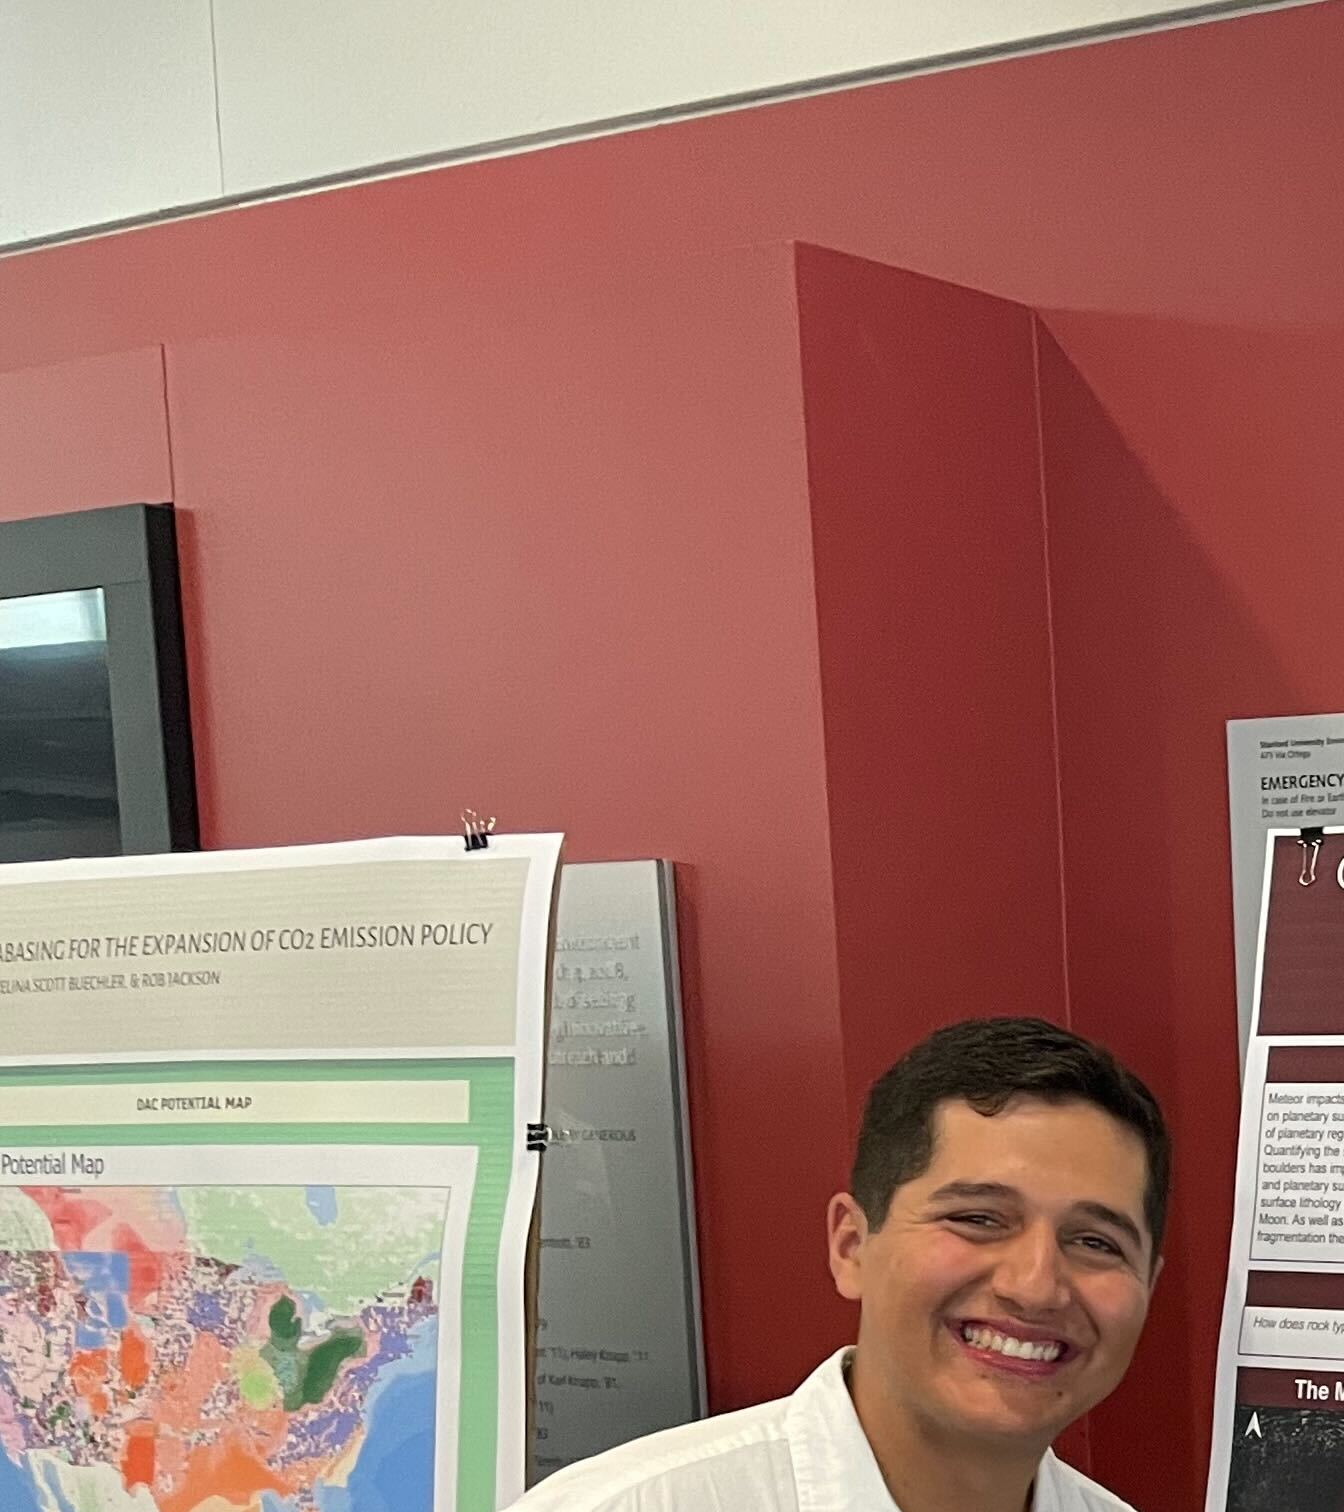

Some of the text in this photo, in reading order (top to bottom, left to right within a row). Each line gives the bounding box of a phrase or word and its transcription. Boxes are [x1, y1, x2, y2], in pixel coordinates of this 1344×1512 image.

[1260, 773, 1344, 791] EMERGENCY
[1289, 794, 1298, 804] of
[68, 938, 100, 959] FOR
[105, 935, 139, 957] THE
[142, 931, 246, 956] EXPANSION
[250, 929, 276, 951] OF
[320, 924, 415, 949] EMISSION
[420, 922, 493, 946] POLICY
[130, 973, 140, 988] &
[136, 1096, 252, 1111] DAC POTENTIAL MAP
[1, 1152, 104, 1175] Potential Map
[1294, 1379, 1329, 1400] The
